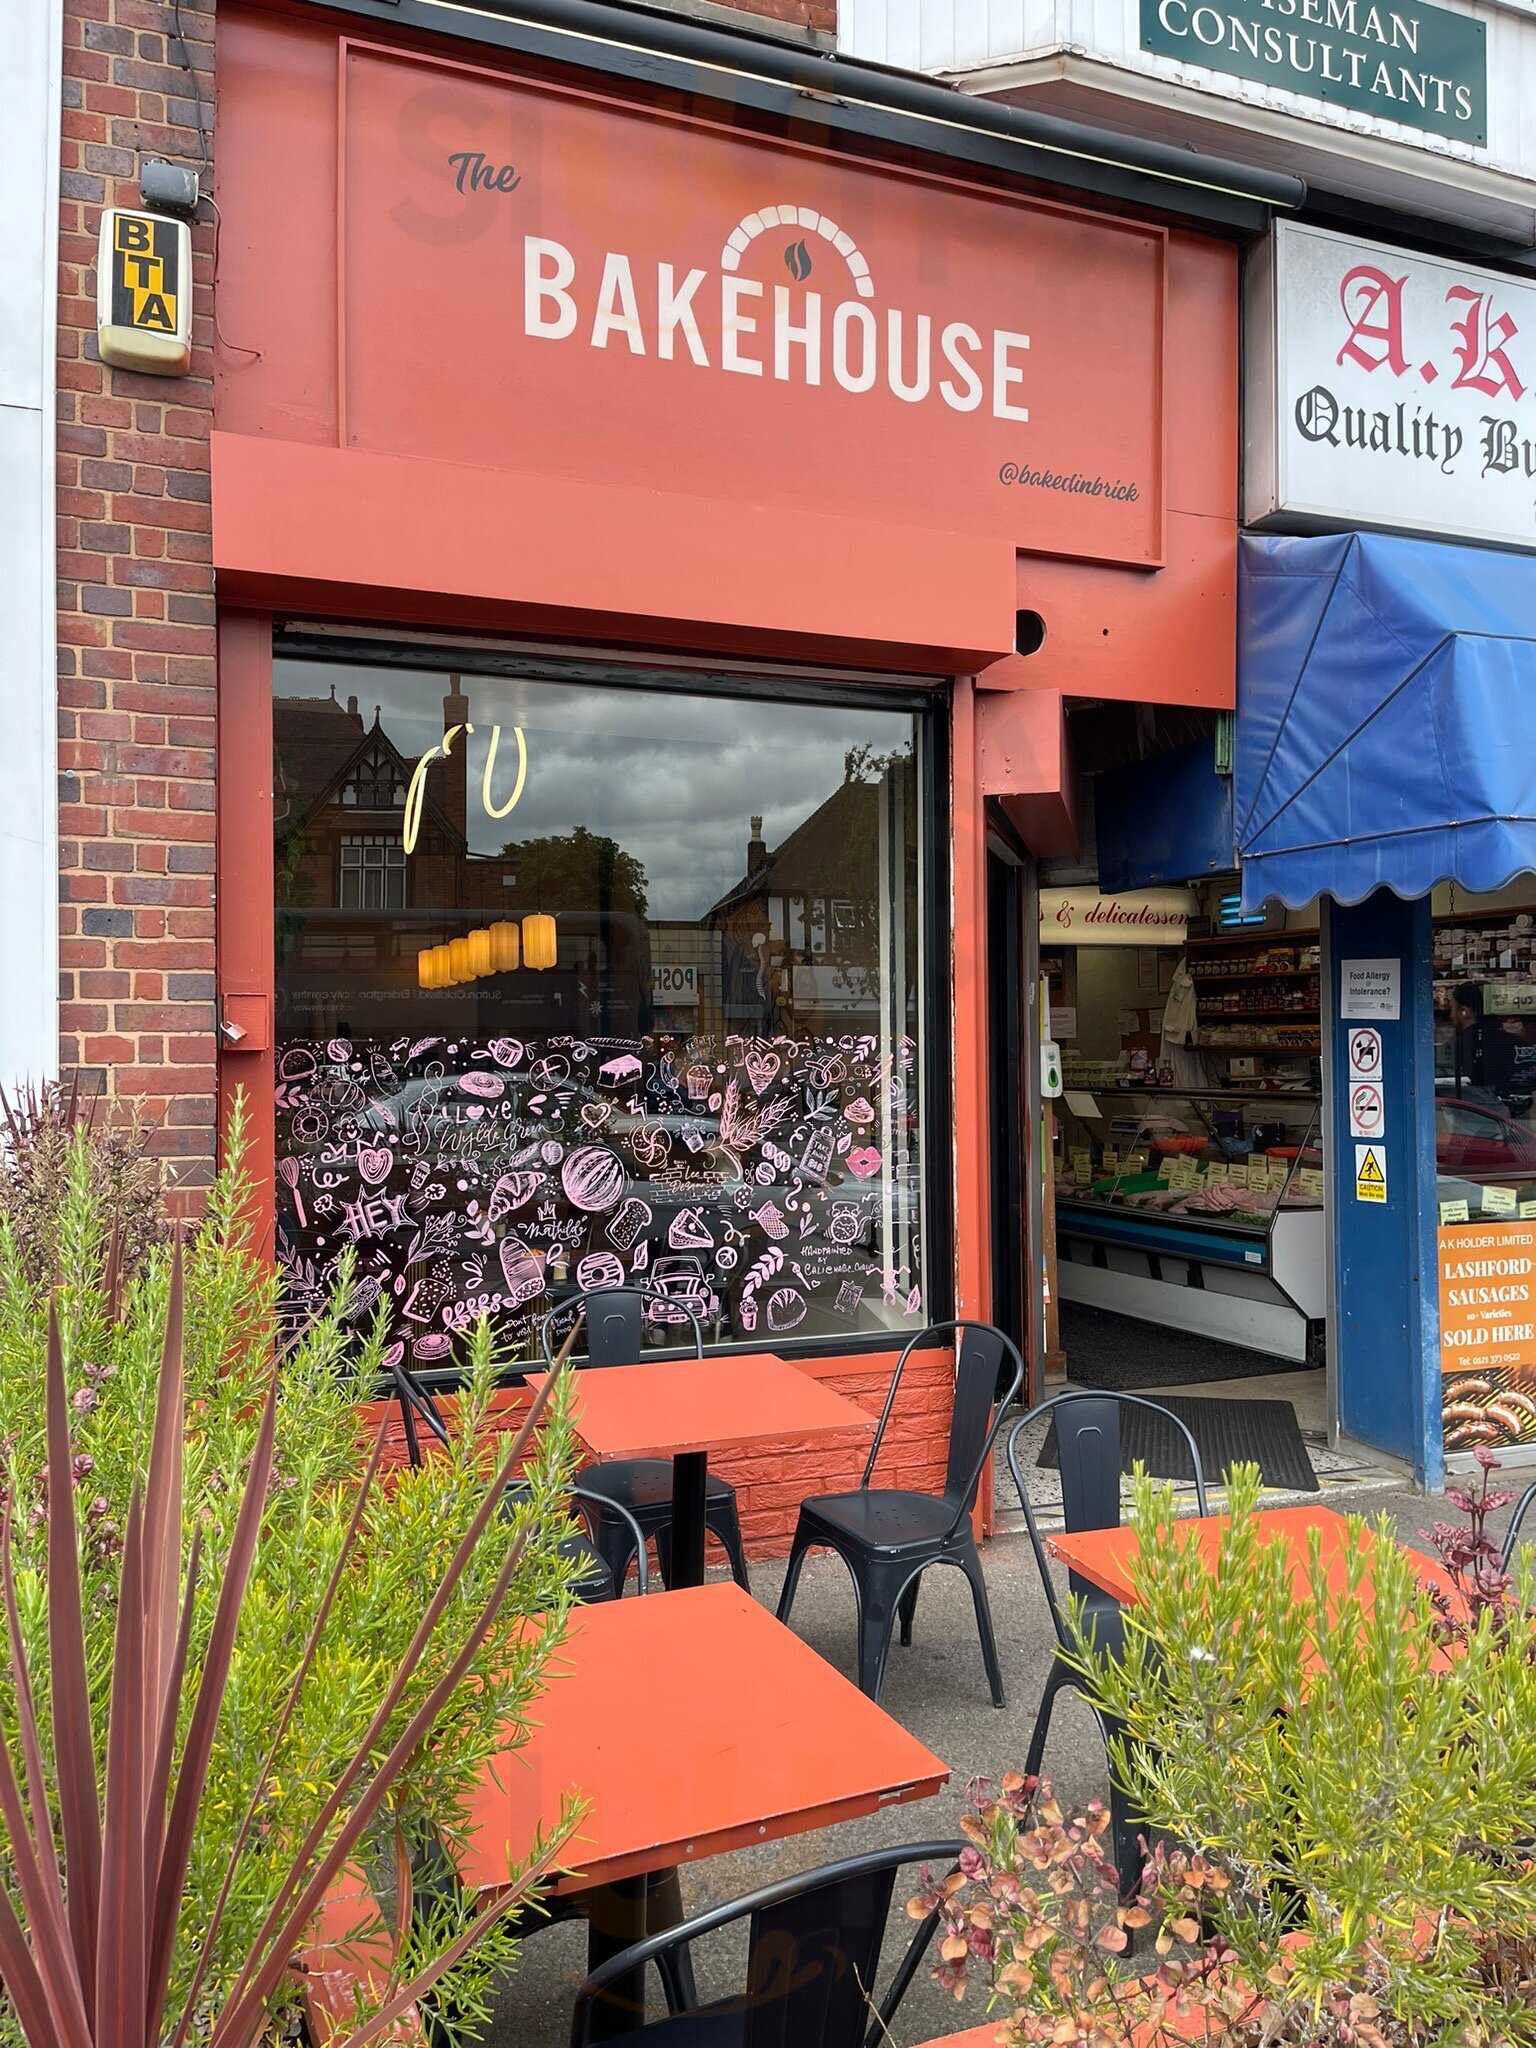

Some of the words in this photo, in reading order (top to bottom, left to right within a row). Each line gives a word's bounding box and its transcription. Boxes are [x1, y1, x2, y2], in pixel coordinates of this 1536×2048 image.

[1243, 0, 1419, 54] SEMAN
[1158, 0, 1472, 120] CONSULTANTS
[448, 152, 522, 196] The
[524, 235, 1031, 423] BAKEHOUSE
[1295, 385, 1463, 475] Quality
[999, 462, 1140, 502] @bakedinbrick
[1056, 900, 1074, 929] &
[1085, 901, 1187, 925] delicatessen
[1349, 972, 1365, 980] Food
[1365, 971, 1391, 981] Allergy
[1349, 987, 1391, 996] Intolerance?
[434, 1120, 501, 1158] Wylde
[1359, 1183, 1384, 1193] CAUTION
[346, 1194, 401, 1236] HEY
[1439, 1239, 1447, 1249] A
[1447, 1238, 1455, 1249] K
[1456, 1236, 1495, 1249] HOLDER
[1496, 1234, 1533, 1246] LIMITED
[1445, 1258, 1532, 1279] LASHFORD
[1448, 1284, 1530, 1307] SAUSAGES
[1480, 1308, 1512, 1320] Varieties
[1443, 1327, 1489, 1347] SOLD
[1491, 1324, 1534, 1343] HERE
[1472, 1356, 1489, 1365] 0121
[1489, 1354, 1502, 1364] 373
[1503, 1352, 1521, 1362] 0522
